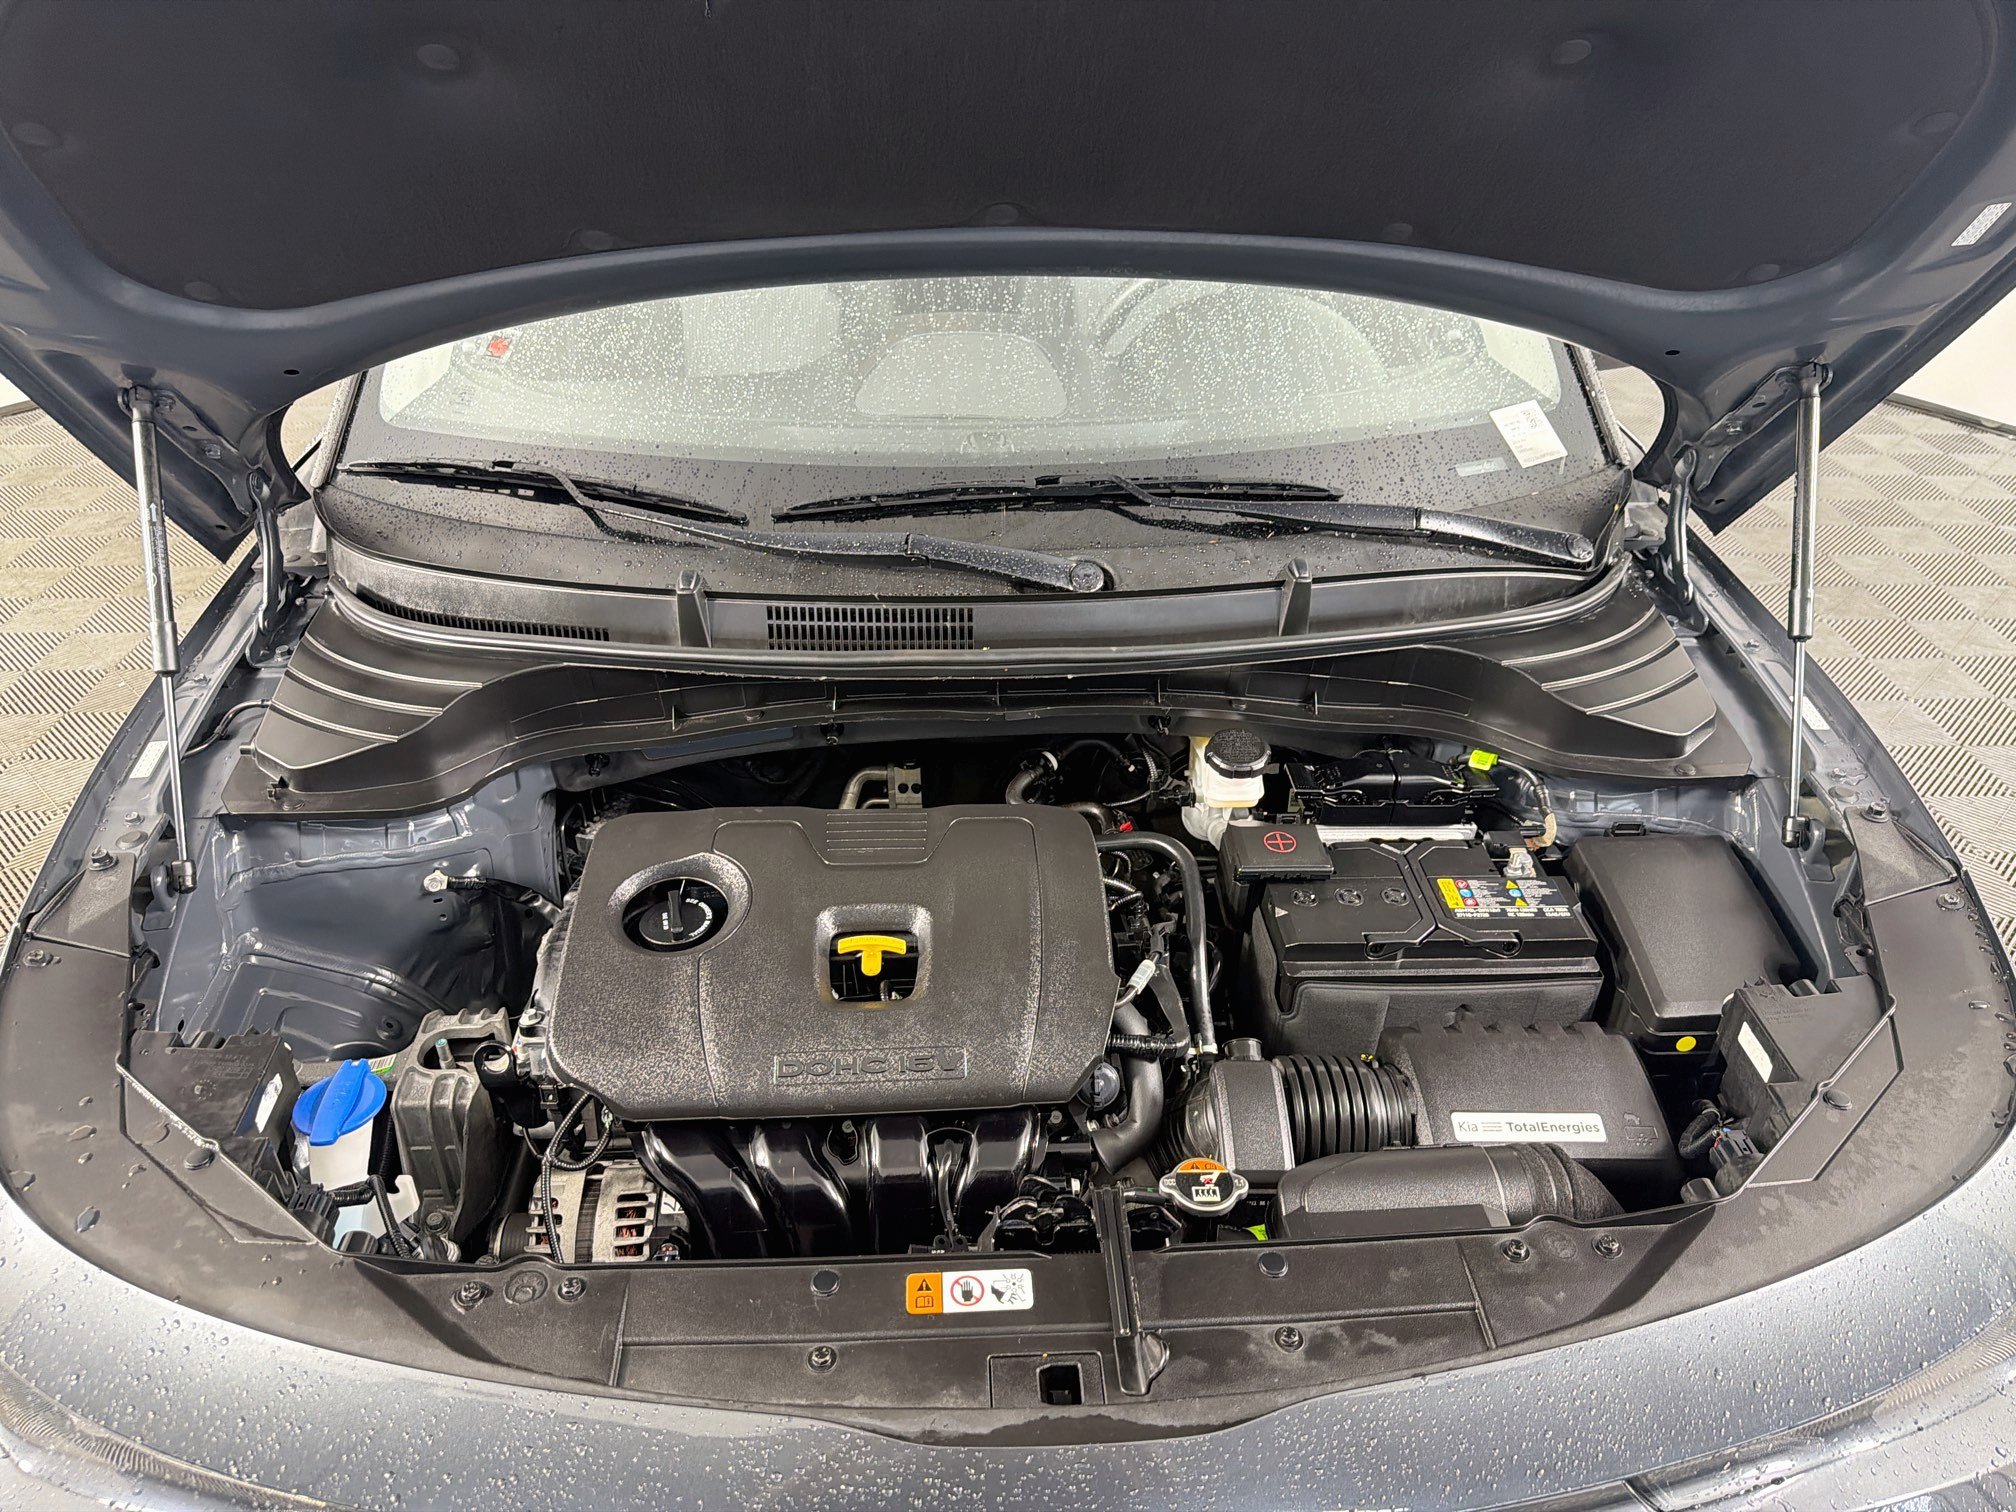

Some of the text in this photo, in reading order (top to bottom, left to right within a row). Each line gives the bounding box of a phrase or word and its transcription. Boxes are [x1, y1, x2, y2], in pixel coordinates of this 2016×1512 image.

[777, 1050, 965, 1077] DOHC 16V
[1458, 1121, 1600, 1136] Kia TotalEnergies
